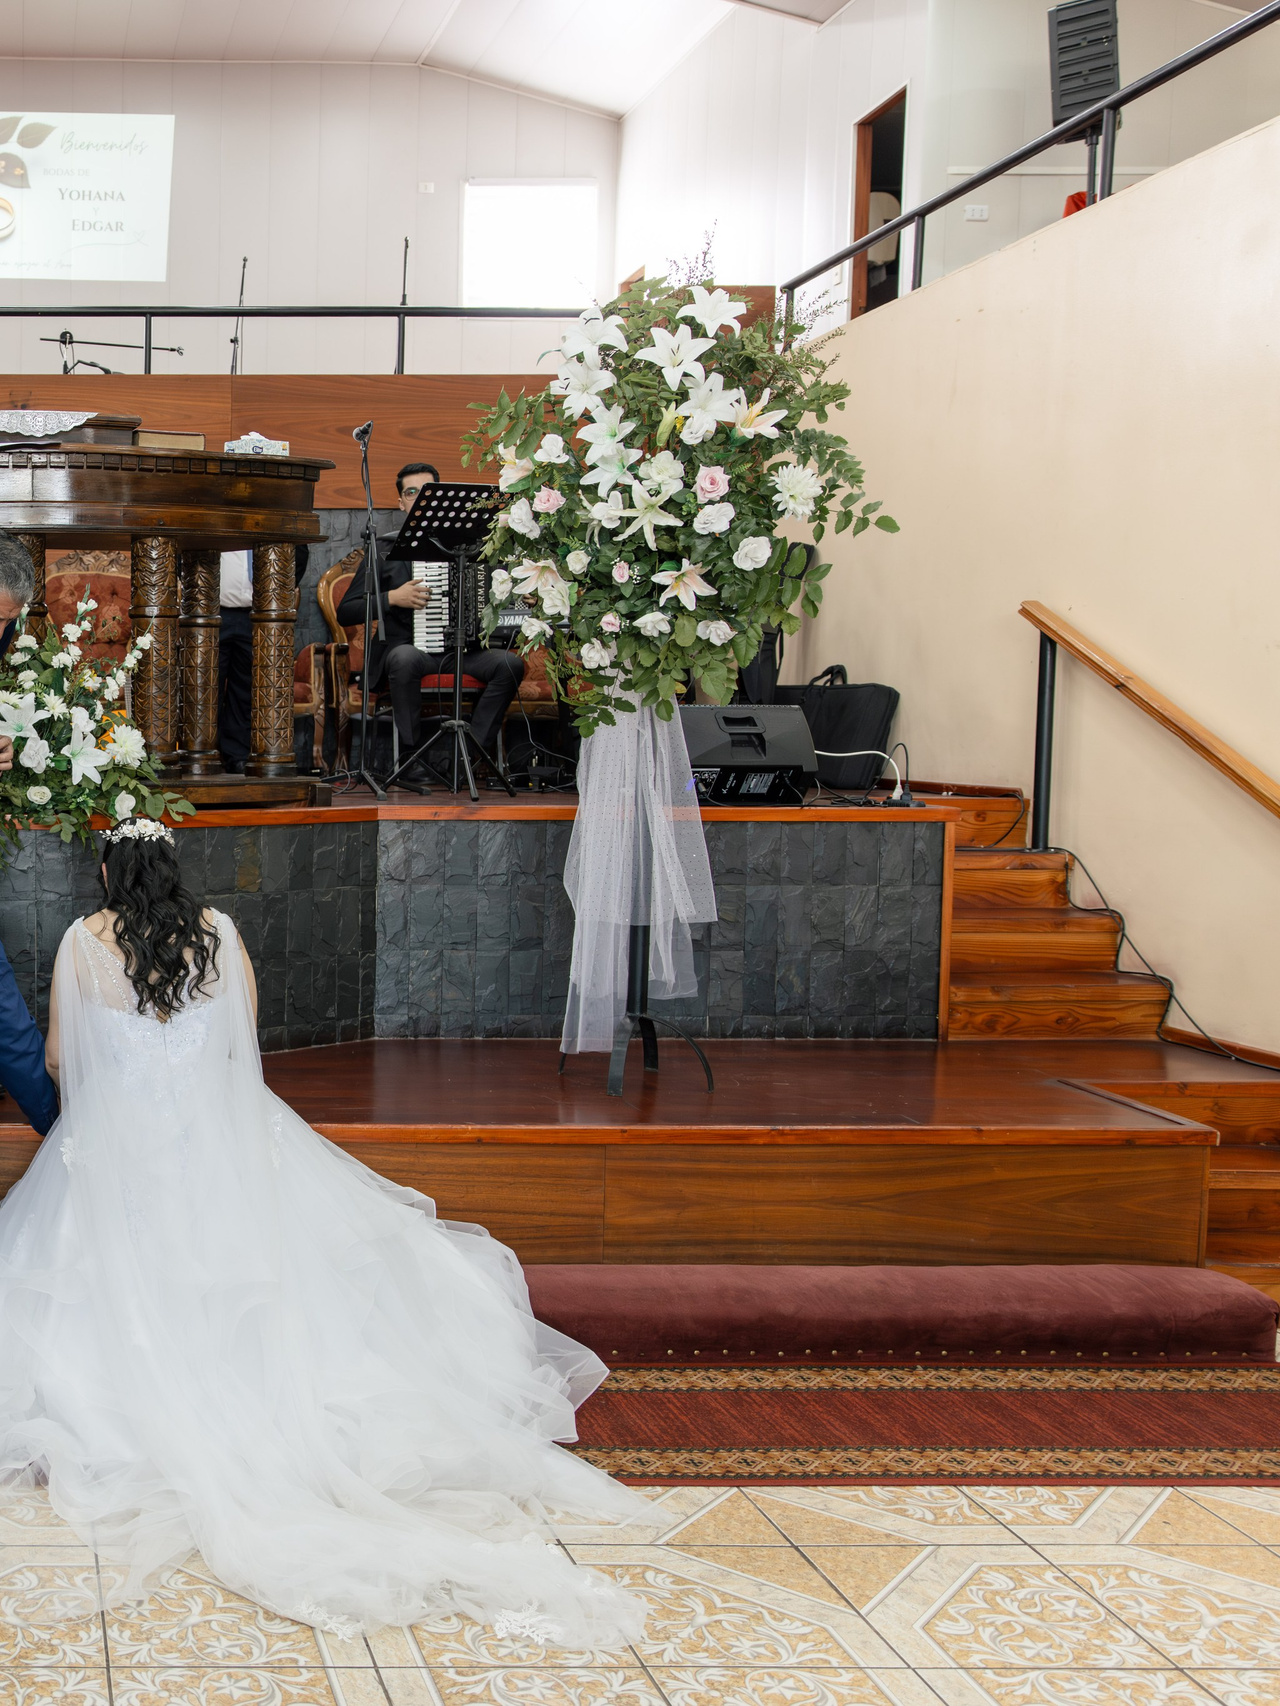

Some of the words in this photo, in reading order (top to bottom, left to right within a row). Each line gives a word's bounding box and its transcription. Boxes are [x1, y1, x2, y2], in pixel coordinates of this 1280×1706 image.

[60, 131, 148, 156] Bienvenidos
[43, 167, 75, 177] BODAS
[77, 168, 90, 177] DE
[58, 187, 126, 202] YOHANA
[92, 207, 100, 216] Y
[71, 219, 125, 232] EDGAR
[504, 614, 531, 626] YAMA
